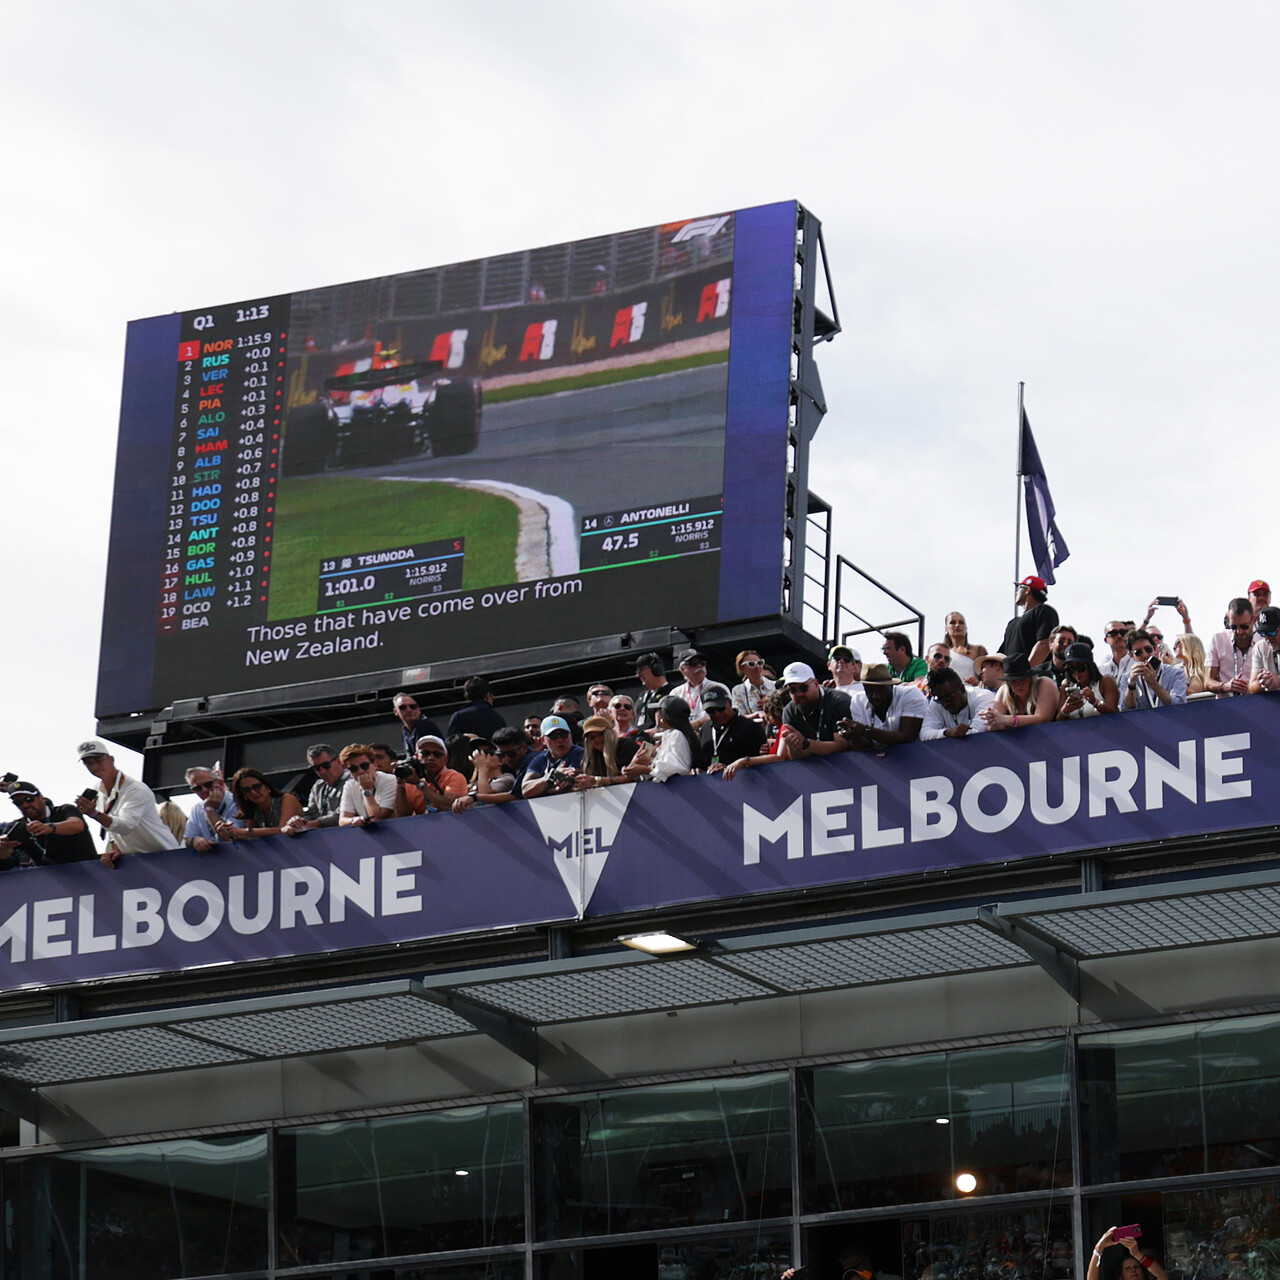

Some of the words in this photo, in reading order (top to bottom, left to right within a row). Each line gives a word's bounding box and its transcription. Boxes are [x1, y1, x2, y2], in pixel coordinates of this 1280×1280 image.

[193, 315, 215, 330] Q1
[236, 305, 270, 322] 1:13
[203, 339, 233, 353] NOR
[237, 332, 272, 348] 1:15.9
[202, 354, 230, 368] RUS
[245, 347, 271, 359] +0.0
[202, 368, 229, 382] VER
[244, 361, 269, 373] +0.1
[200, 383, 225, 397] LEC
[243, 375, 268, 388] +0.1
[199, 398, 222, 411] PIA
[242, 390, 266, 402] +0.1
[197, 411, 226, 425] ALO
[241, 404, 266, 416] +0.3
[196, 427, 219, 440] SAI
[240, 419, 265, 431] +0.4
[195, 439, 229, 454] HAM
[239, 433, 264, 445] +0.4
[194, 455, 221, 468] ALB
[238, 447, 263, 460] +0.6
[193, 470, 221, 483] STR
[236, 462, 262, 475] +0.7
[192, 484, 222, 498] HAD
[235, 477, 260, 489] +0.8
[190, 498, 221, 512] DOO
[234, 491, 260, 504] +0.8
[190, 513, 218, 526] TSU
[233, 506, 258, 519] +0.8
[584, 519, 598, 530] 14
[620, 503, 690, 524] ANTONELLI
[188, 527, 220, 542] ANT
[232, 521, 257, 533] +0.8
[670, 519, 714, 535] 1:15.912
[675, 531, 709, 543] NORRIS
[187, 542, 216, 556] BOR
[231, 535, 256, 548] +0.8
[602, 532, 639, 552] 47.5
[186, 557, 215, 571] GAS
[230, 550, 255, 563] +0.9
[322, 561, 336, 572] 13
[357, 549, 415, 566] TSUNODA
[405, 563, 448, 578] 1:15.912
[185, 572, 213, 585] HUL
[229, 565, 254, 578] +1.0
[409, 574, 442, 586] NORRIS
[184, 586, 216, 600] LAW
[228, 580, 252, 593] +1.1
[324, 575, 375, 597] 1:01.0
[183, 601, 211, 615] OCO
[227, 595, 251, 608] +1.2
[247, 621, 307, 643] Those
[313, 613, 355, 634] that
[361, 606, 411, 627] have
[418, 595, 474, 618] come
[481, 590, 529, 609] over
[533, 578, 583, 600] from
[181, 616, 209, 630] BEA
[245, 648, 289, 666] New
[295, 631, 385, 659] Zealand.
[742, 732, 1252, 865] MELBOURNE
[548, 827, 611, 860] MEL
